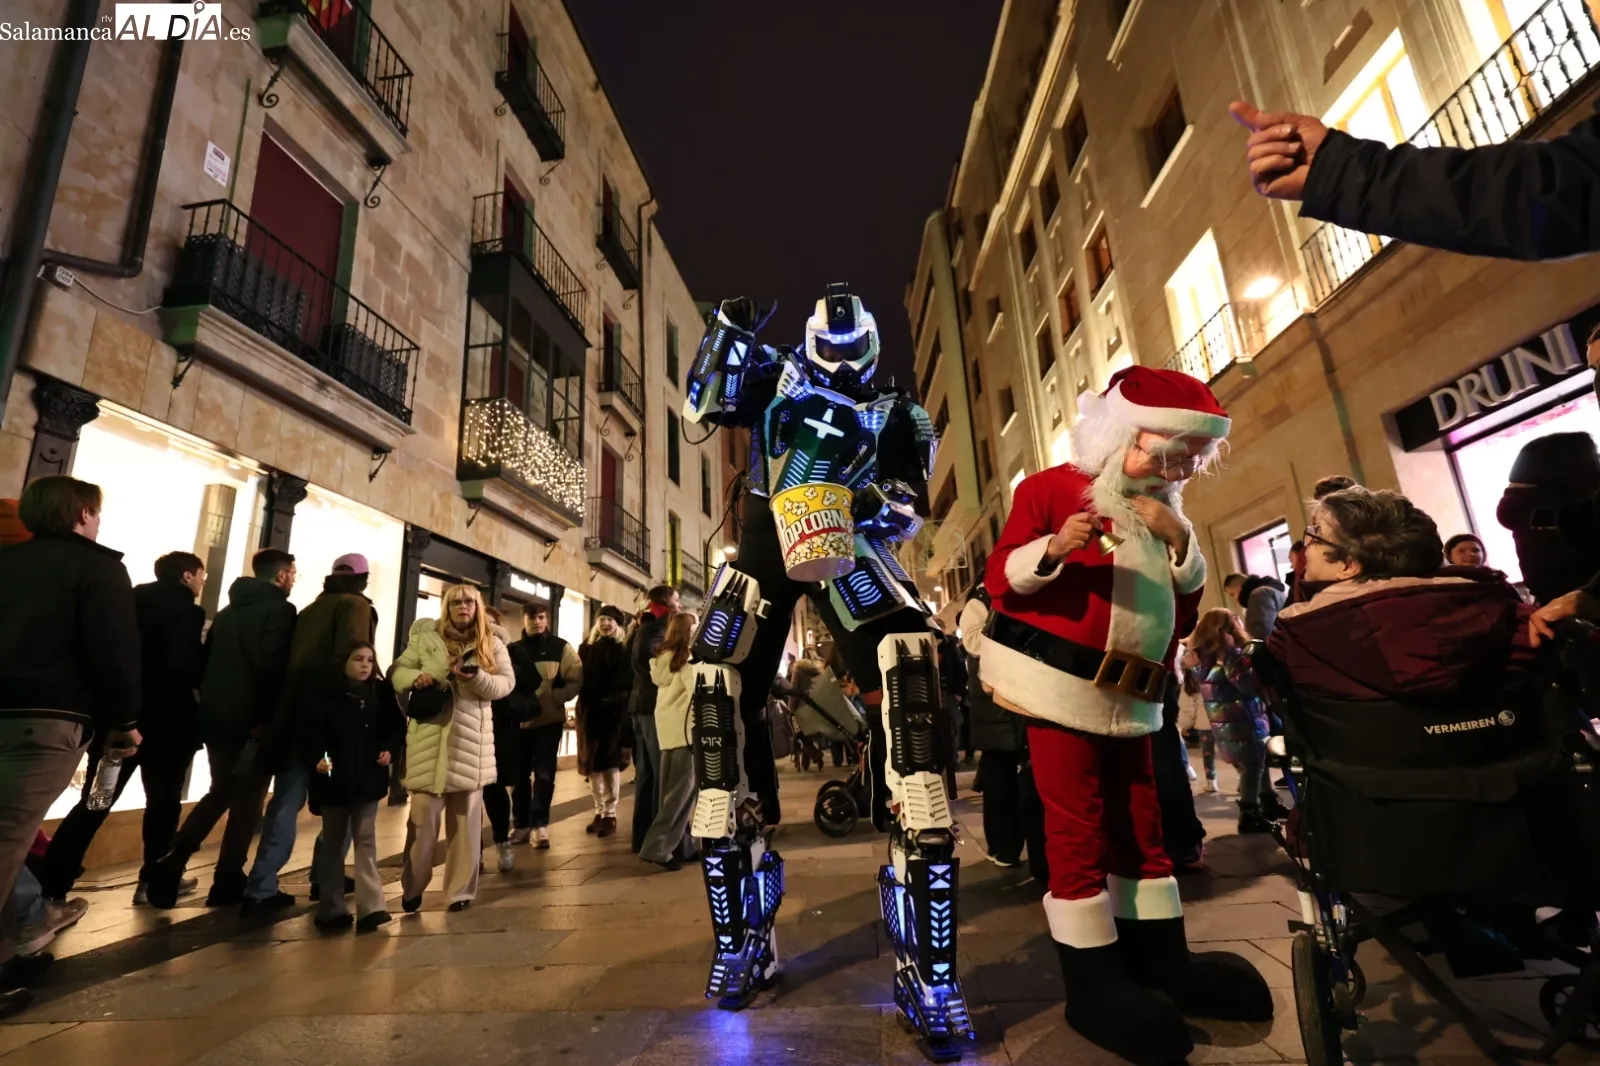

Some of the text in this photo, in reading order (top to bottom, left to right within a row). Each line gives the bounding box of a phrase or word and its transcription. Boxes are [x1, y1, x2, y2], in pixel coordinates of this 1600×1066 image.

[1429, 323, 1584, 431] DRUNI
[777, 509, 845, 550] POPCORN
[1423, 716, 1497, 735] VERMEIREN
